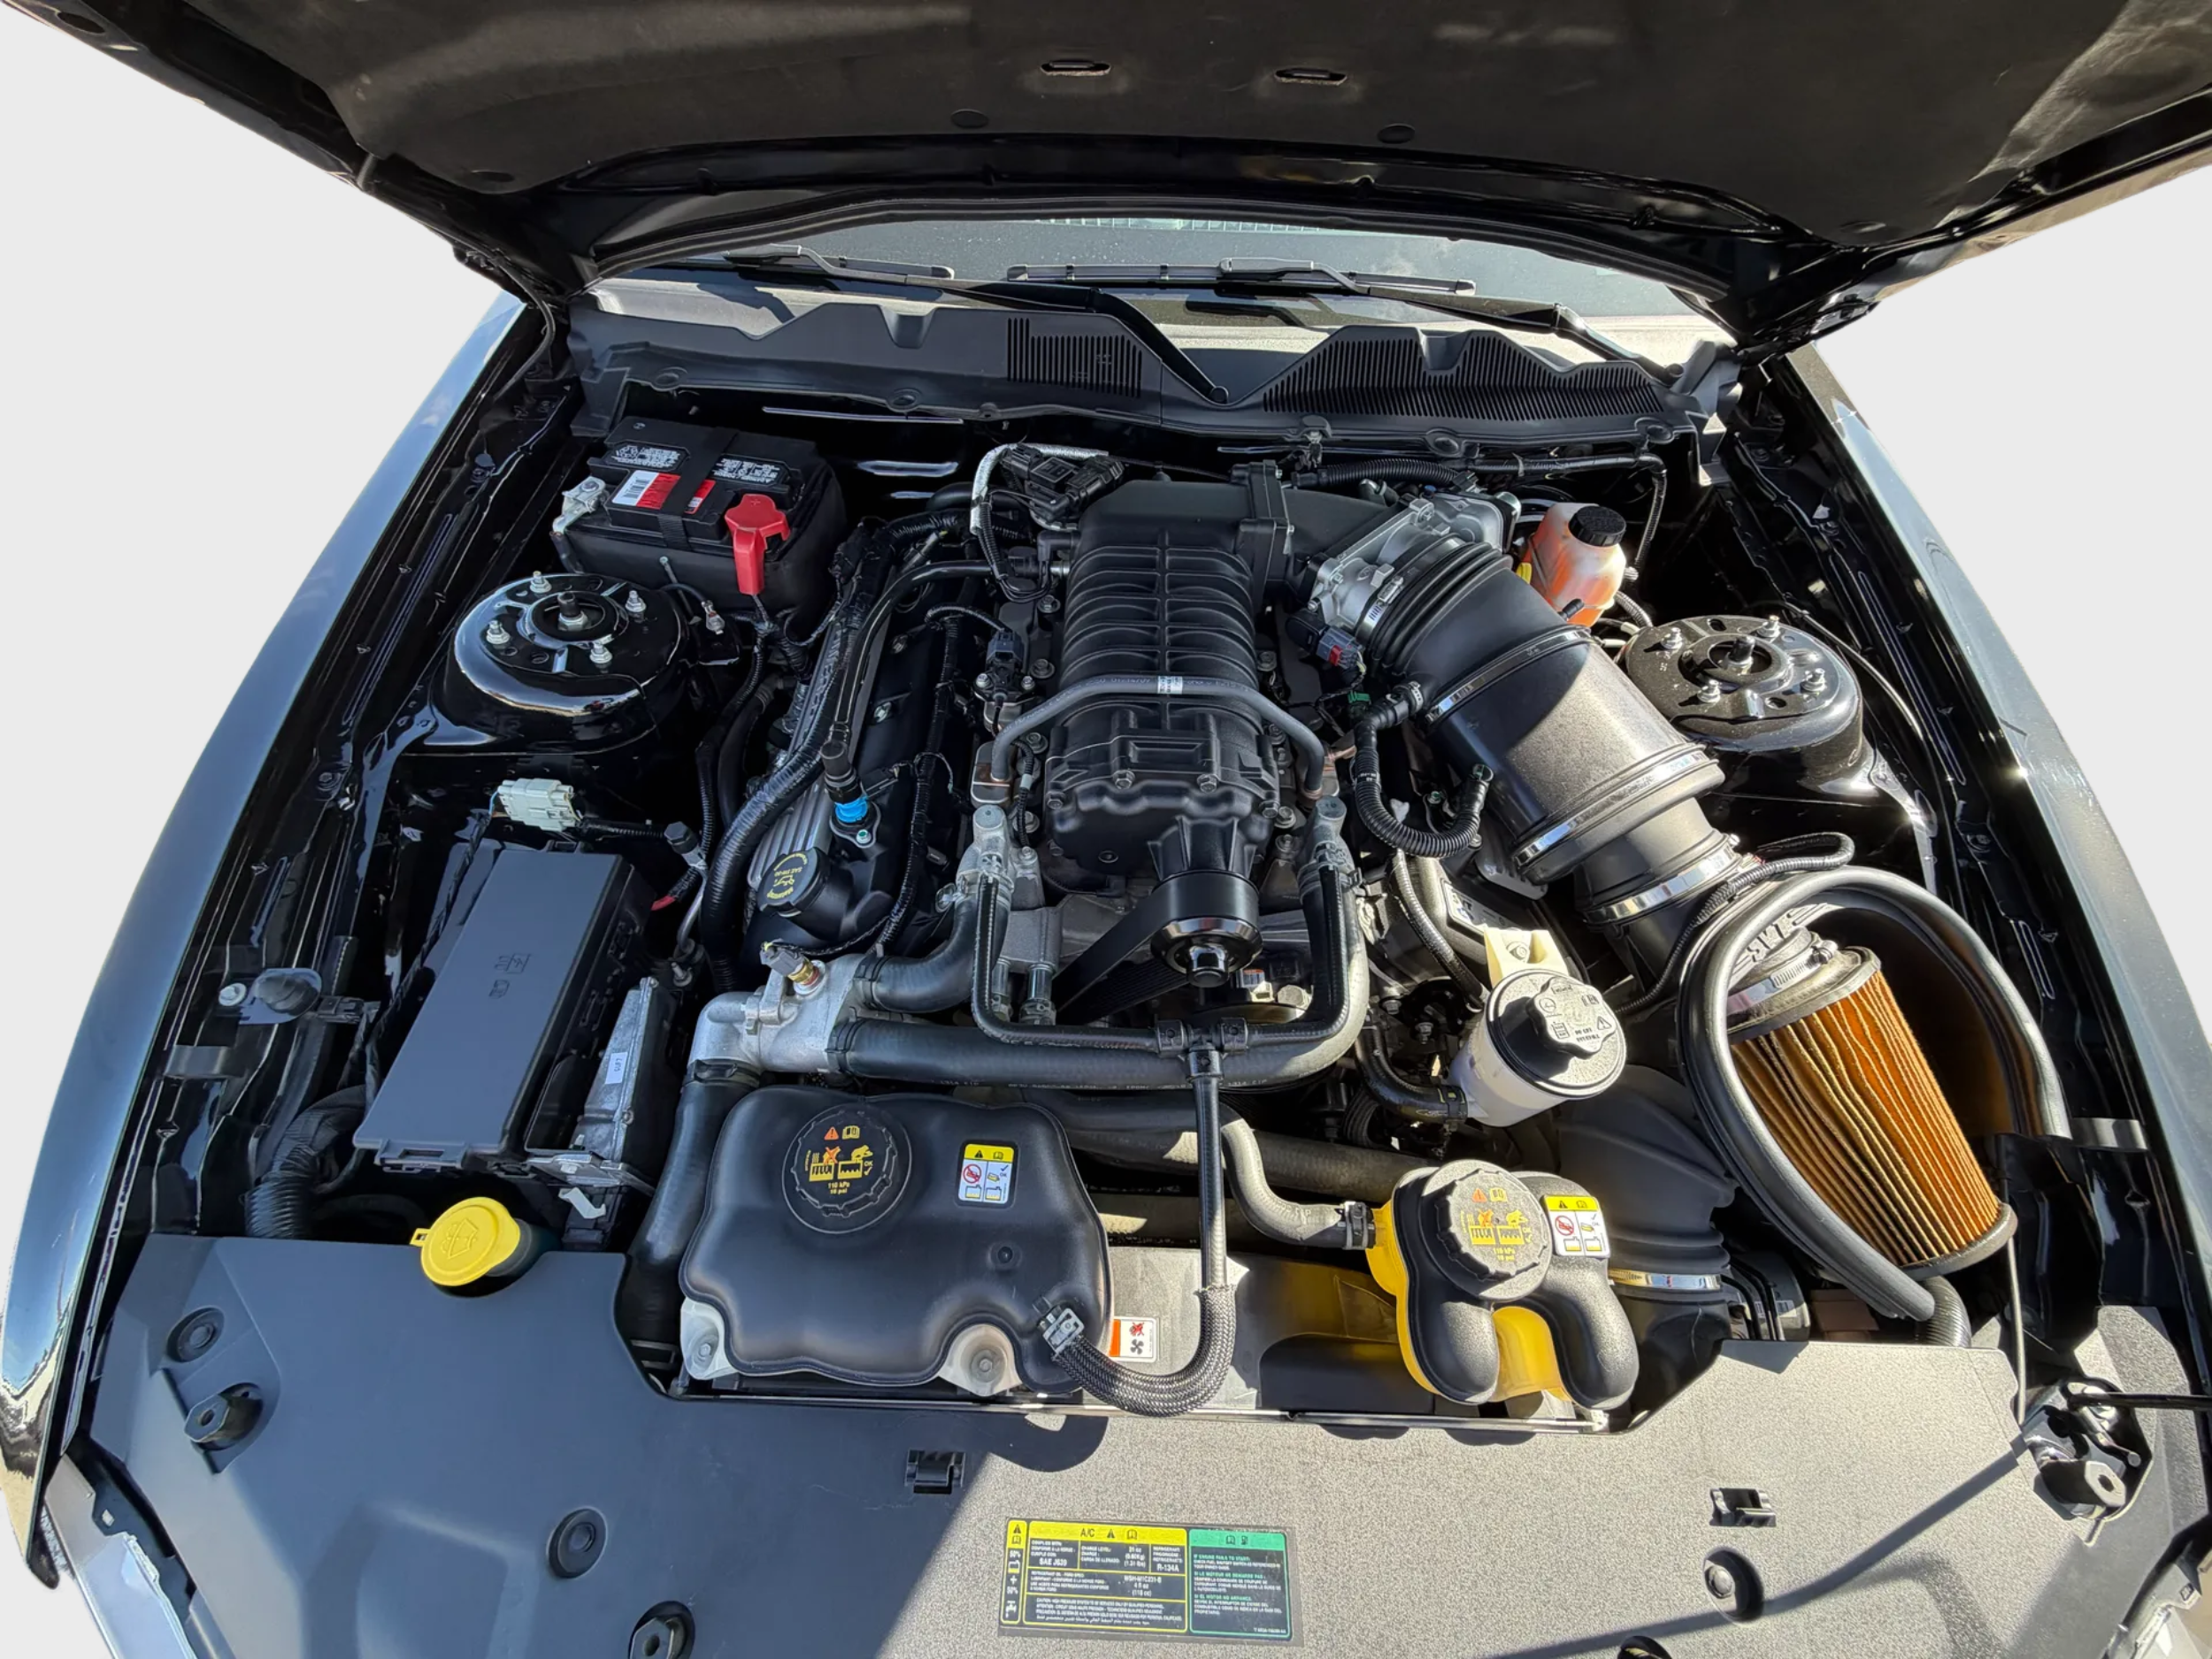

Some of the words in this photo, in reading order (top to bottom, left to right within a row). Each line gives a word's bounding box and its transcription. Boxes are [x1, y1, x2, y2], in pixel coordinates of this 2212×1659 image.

[1080, 1529, 1095, 1538] A/C
[1010, 1549, 1021, 1558] 50%
[1156, 1563, 1179, 1572] R-134A
[1007, 1586, 1018, 1594] 50%
